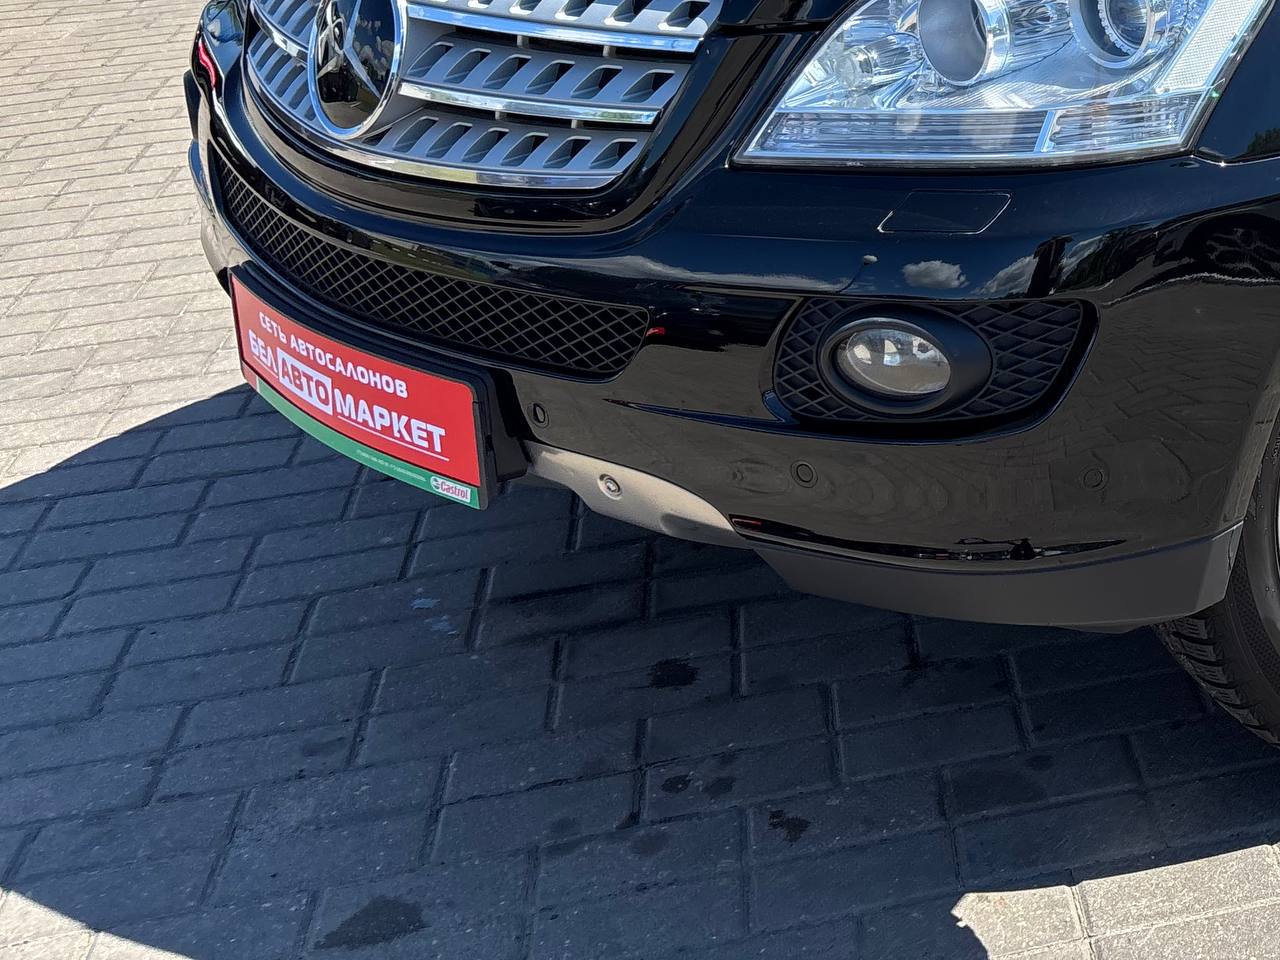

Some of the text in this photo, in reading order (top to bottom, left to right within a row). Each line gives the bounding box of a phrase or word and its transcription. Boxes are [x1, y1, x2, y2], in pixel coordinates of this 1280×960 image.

[258, 311, 288, 344] СЕТЬ
[289, 333, 409, 399] АВТОСАЛОНОВ
[439, 480, 470, 501] Castrol
